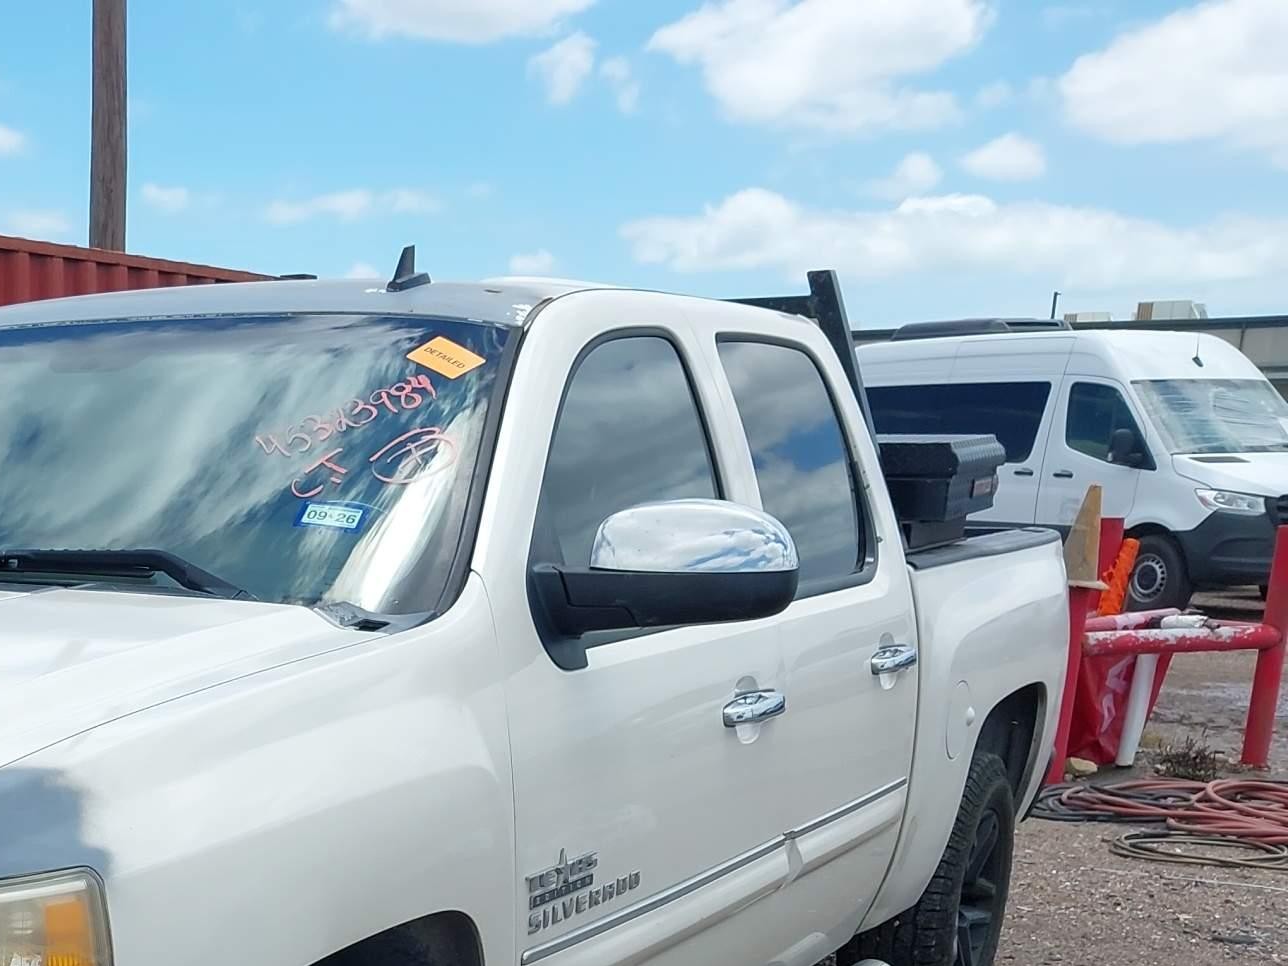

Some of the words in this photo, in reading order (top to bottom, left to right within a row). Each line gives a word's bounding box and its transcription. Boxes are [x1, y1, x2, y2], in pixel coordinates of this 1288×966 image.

[424, 347, 465, 369] DETAILED
[307, 510, 328, 521] 09
[335, 512, 357, 524] 26
[527, 871, 641, 936] SILVERADO
